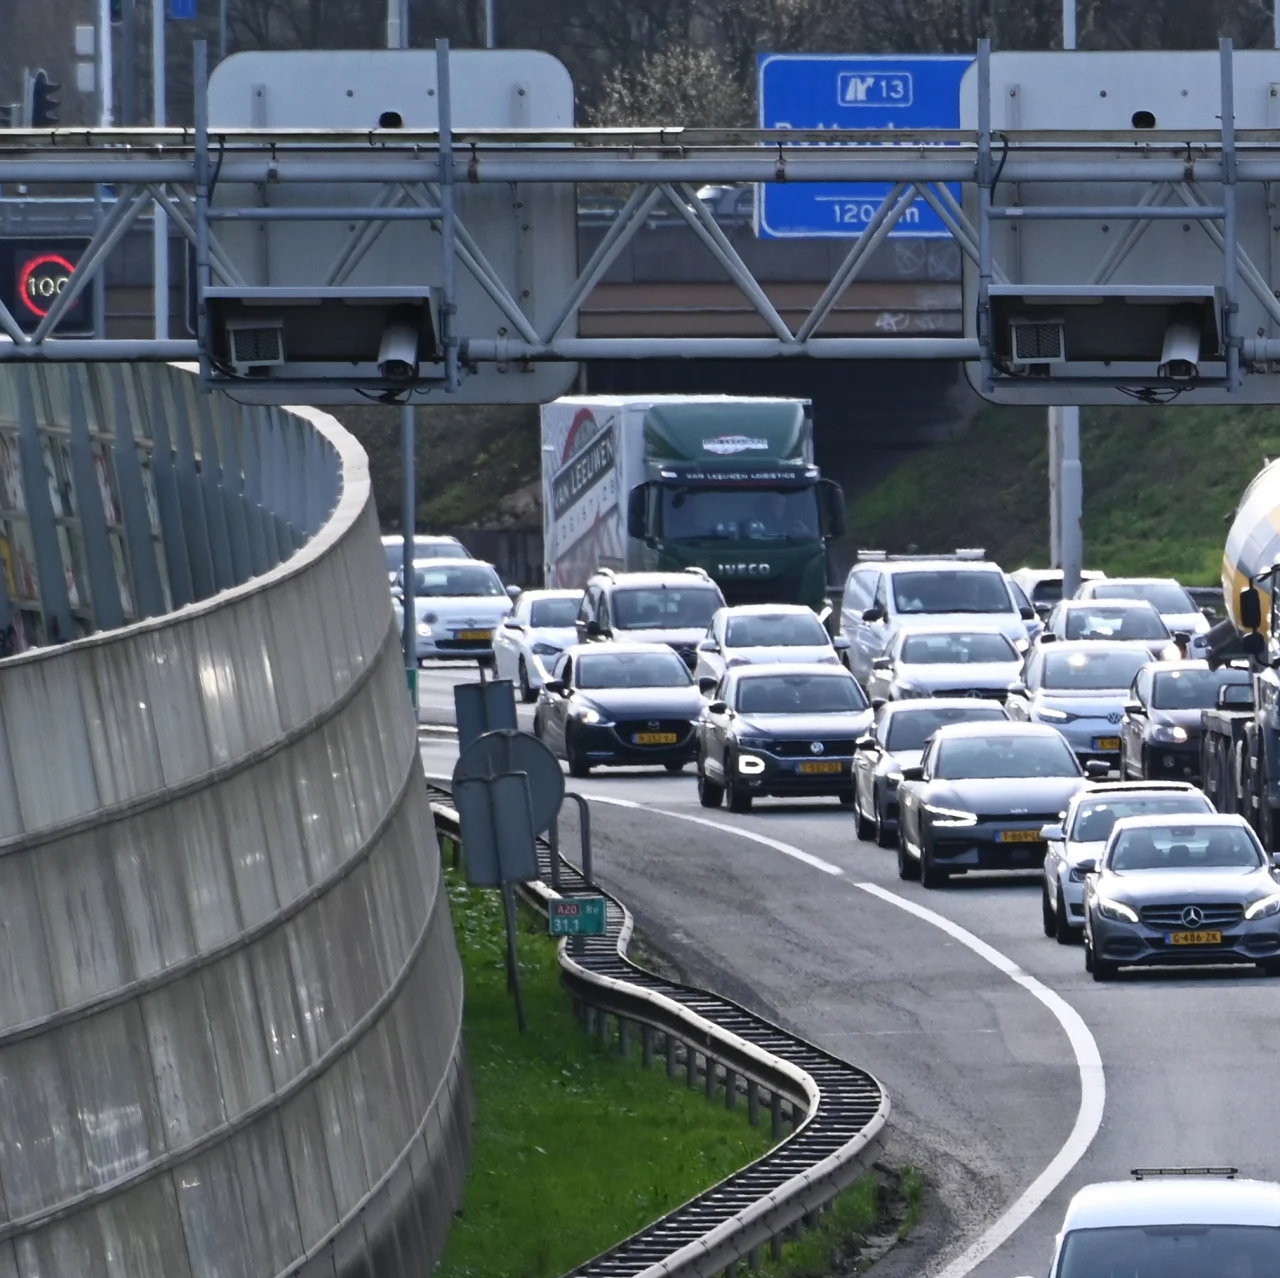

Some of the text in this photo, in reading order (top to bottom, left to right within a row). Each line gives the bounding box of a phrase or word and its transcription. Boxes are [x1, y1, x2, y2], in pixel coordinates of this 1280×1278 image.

[879, 79, 904, 99] 13
[834, 205, 876, 223] 120
[571, 434, 614, 495] LEEUWEN
[717, 563, 770, 576] IVECO
[557, 904, 578, 914] A20
[553, 918, 580, 933] 31,1
